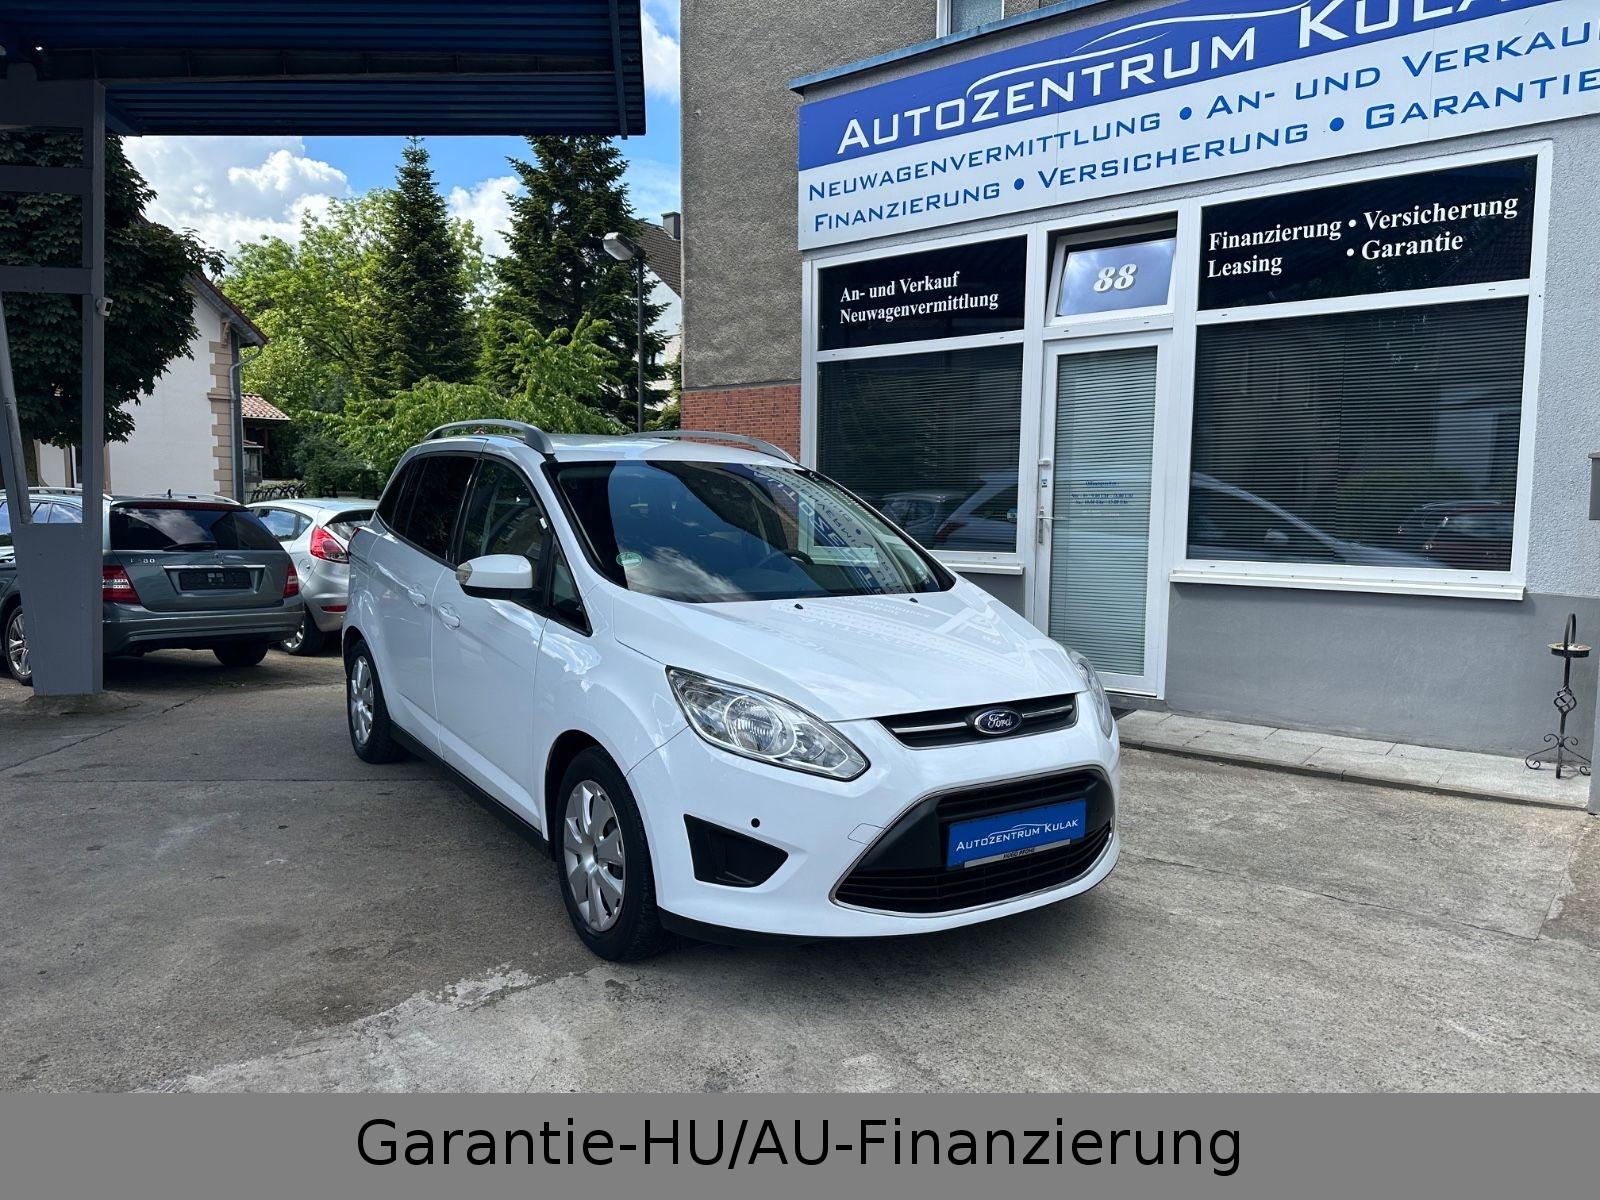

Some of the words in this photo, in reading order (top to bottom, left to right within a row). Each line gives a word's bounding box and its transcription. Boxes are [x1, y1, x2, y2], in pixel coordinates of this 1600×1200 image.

[837, 27, 1255, 154] AUTOZENTRUM
[1298, 0, 1511, 49] KUL
[809, 112, 1161, 201] NEUWAGENVERMITTLUNG
[1206, 92, 1275, 119] AN-
[1295, 67, 1381, 101] UND
[1402, 20, 1600, 78] VERKAU
[814, 183, 1000, 232] FINANZIERUNG
[1037, 124, 1308, 189] VERSICHERUNG
[1365, 68, 1600, 130] GARANTIE
[1208, 218, 1342, 252] Finanzierung
[1363, 197, 1519, 231] Versicherung
[1207, 254, 1283, 278] Leasing
[1361, 231, 1464, 260] Garantie
[840, 287, 866, 302] An-
[869, 281, 895, 299] und
[899, 271, 960, 294] Verkauf
[1093, 263, 1137, 292] 88
[839, 293, 999, 324] Neuwagenvermittlung
[987, 713, 1012, 729] Ford
[955, 827, 1040, 852] AUTOZENTRUM
[1044, 819, 1079, 833] KULAK
